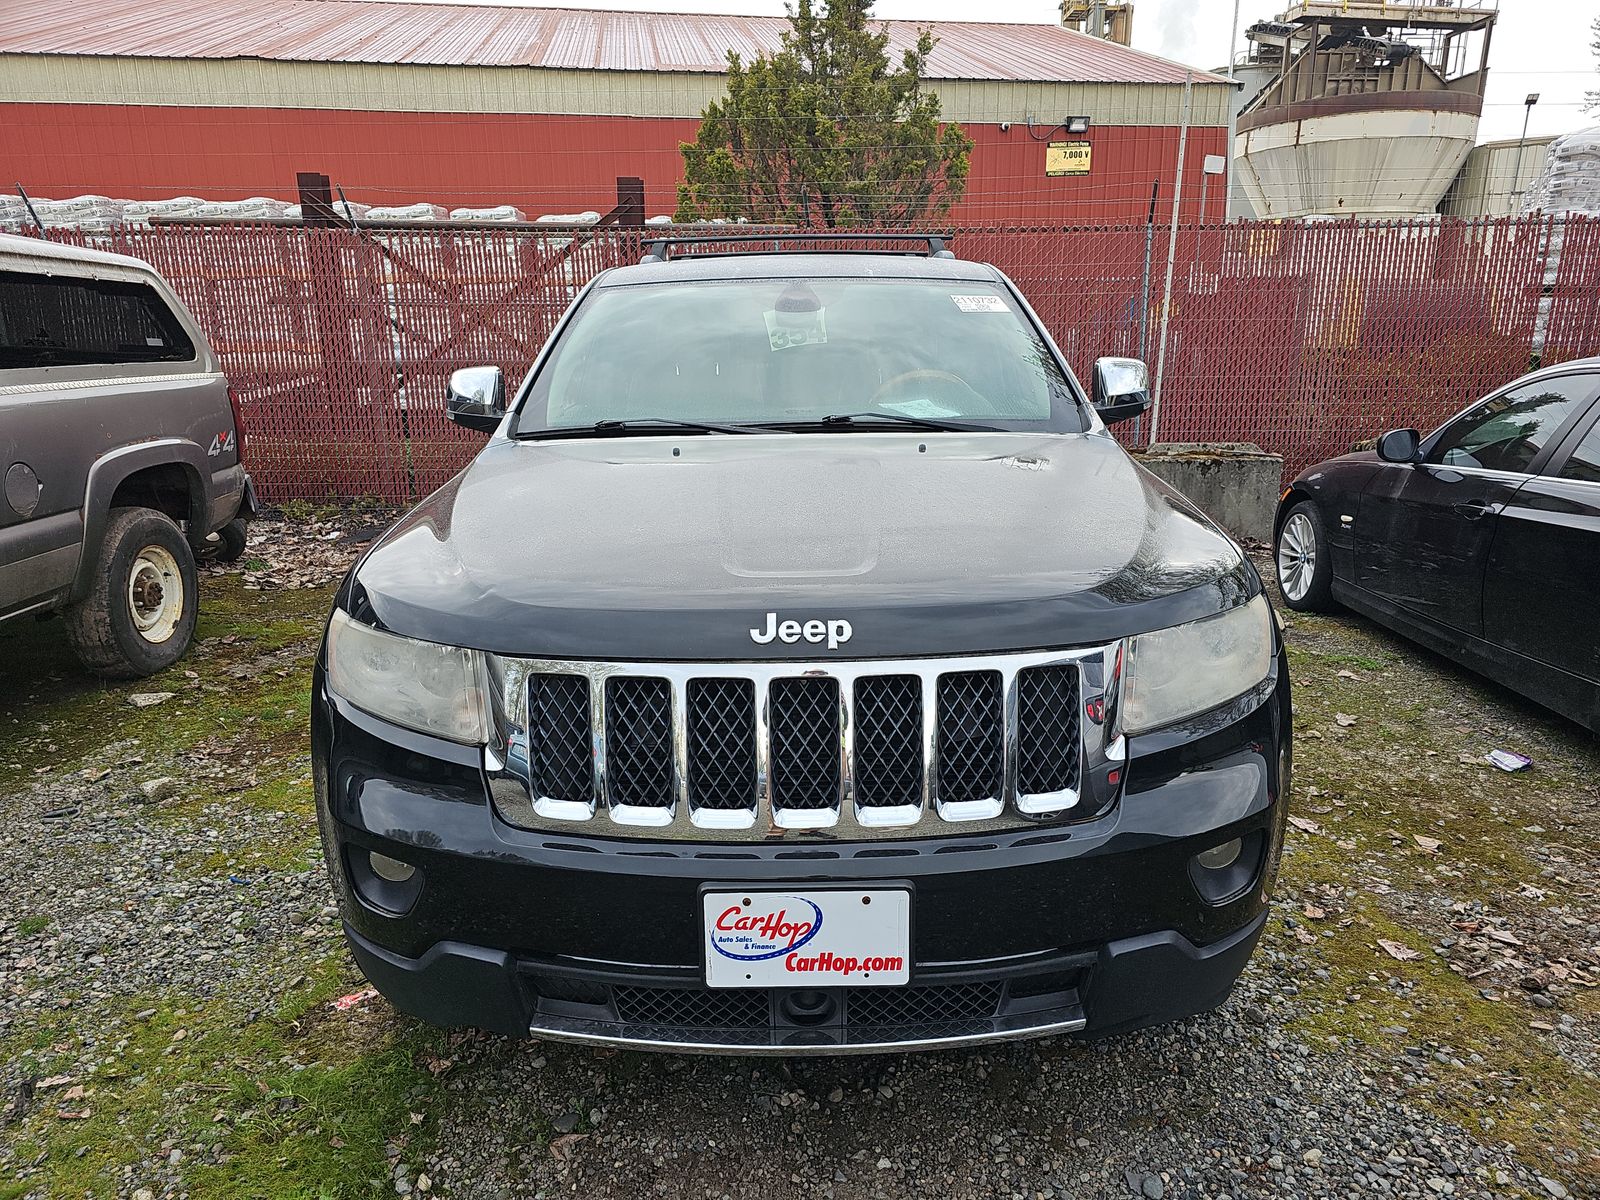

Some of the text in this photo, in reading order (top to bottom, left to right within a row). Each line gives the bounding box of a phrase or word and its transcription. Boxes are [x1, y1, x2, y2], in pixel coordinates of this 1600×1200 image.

[1063, 151, 1083, 160] 7,000
[953, 296, 1000, 304] 2110732
[749, 612, 853, 650] Jeep
[716, 906, 812, 948] CarHop
[785, 952, 904, 976] CarHop.com
